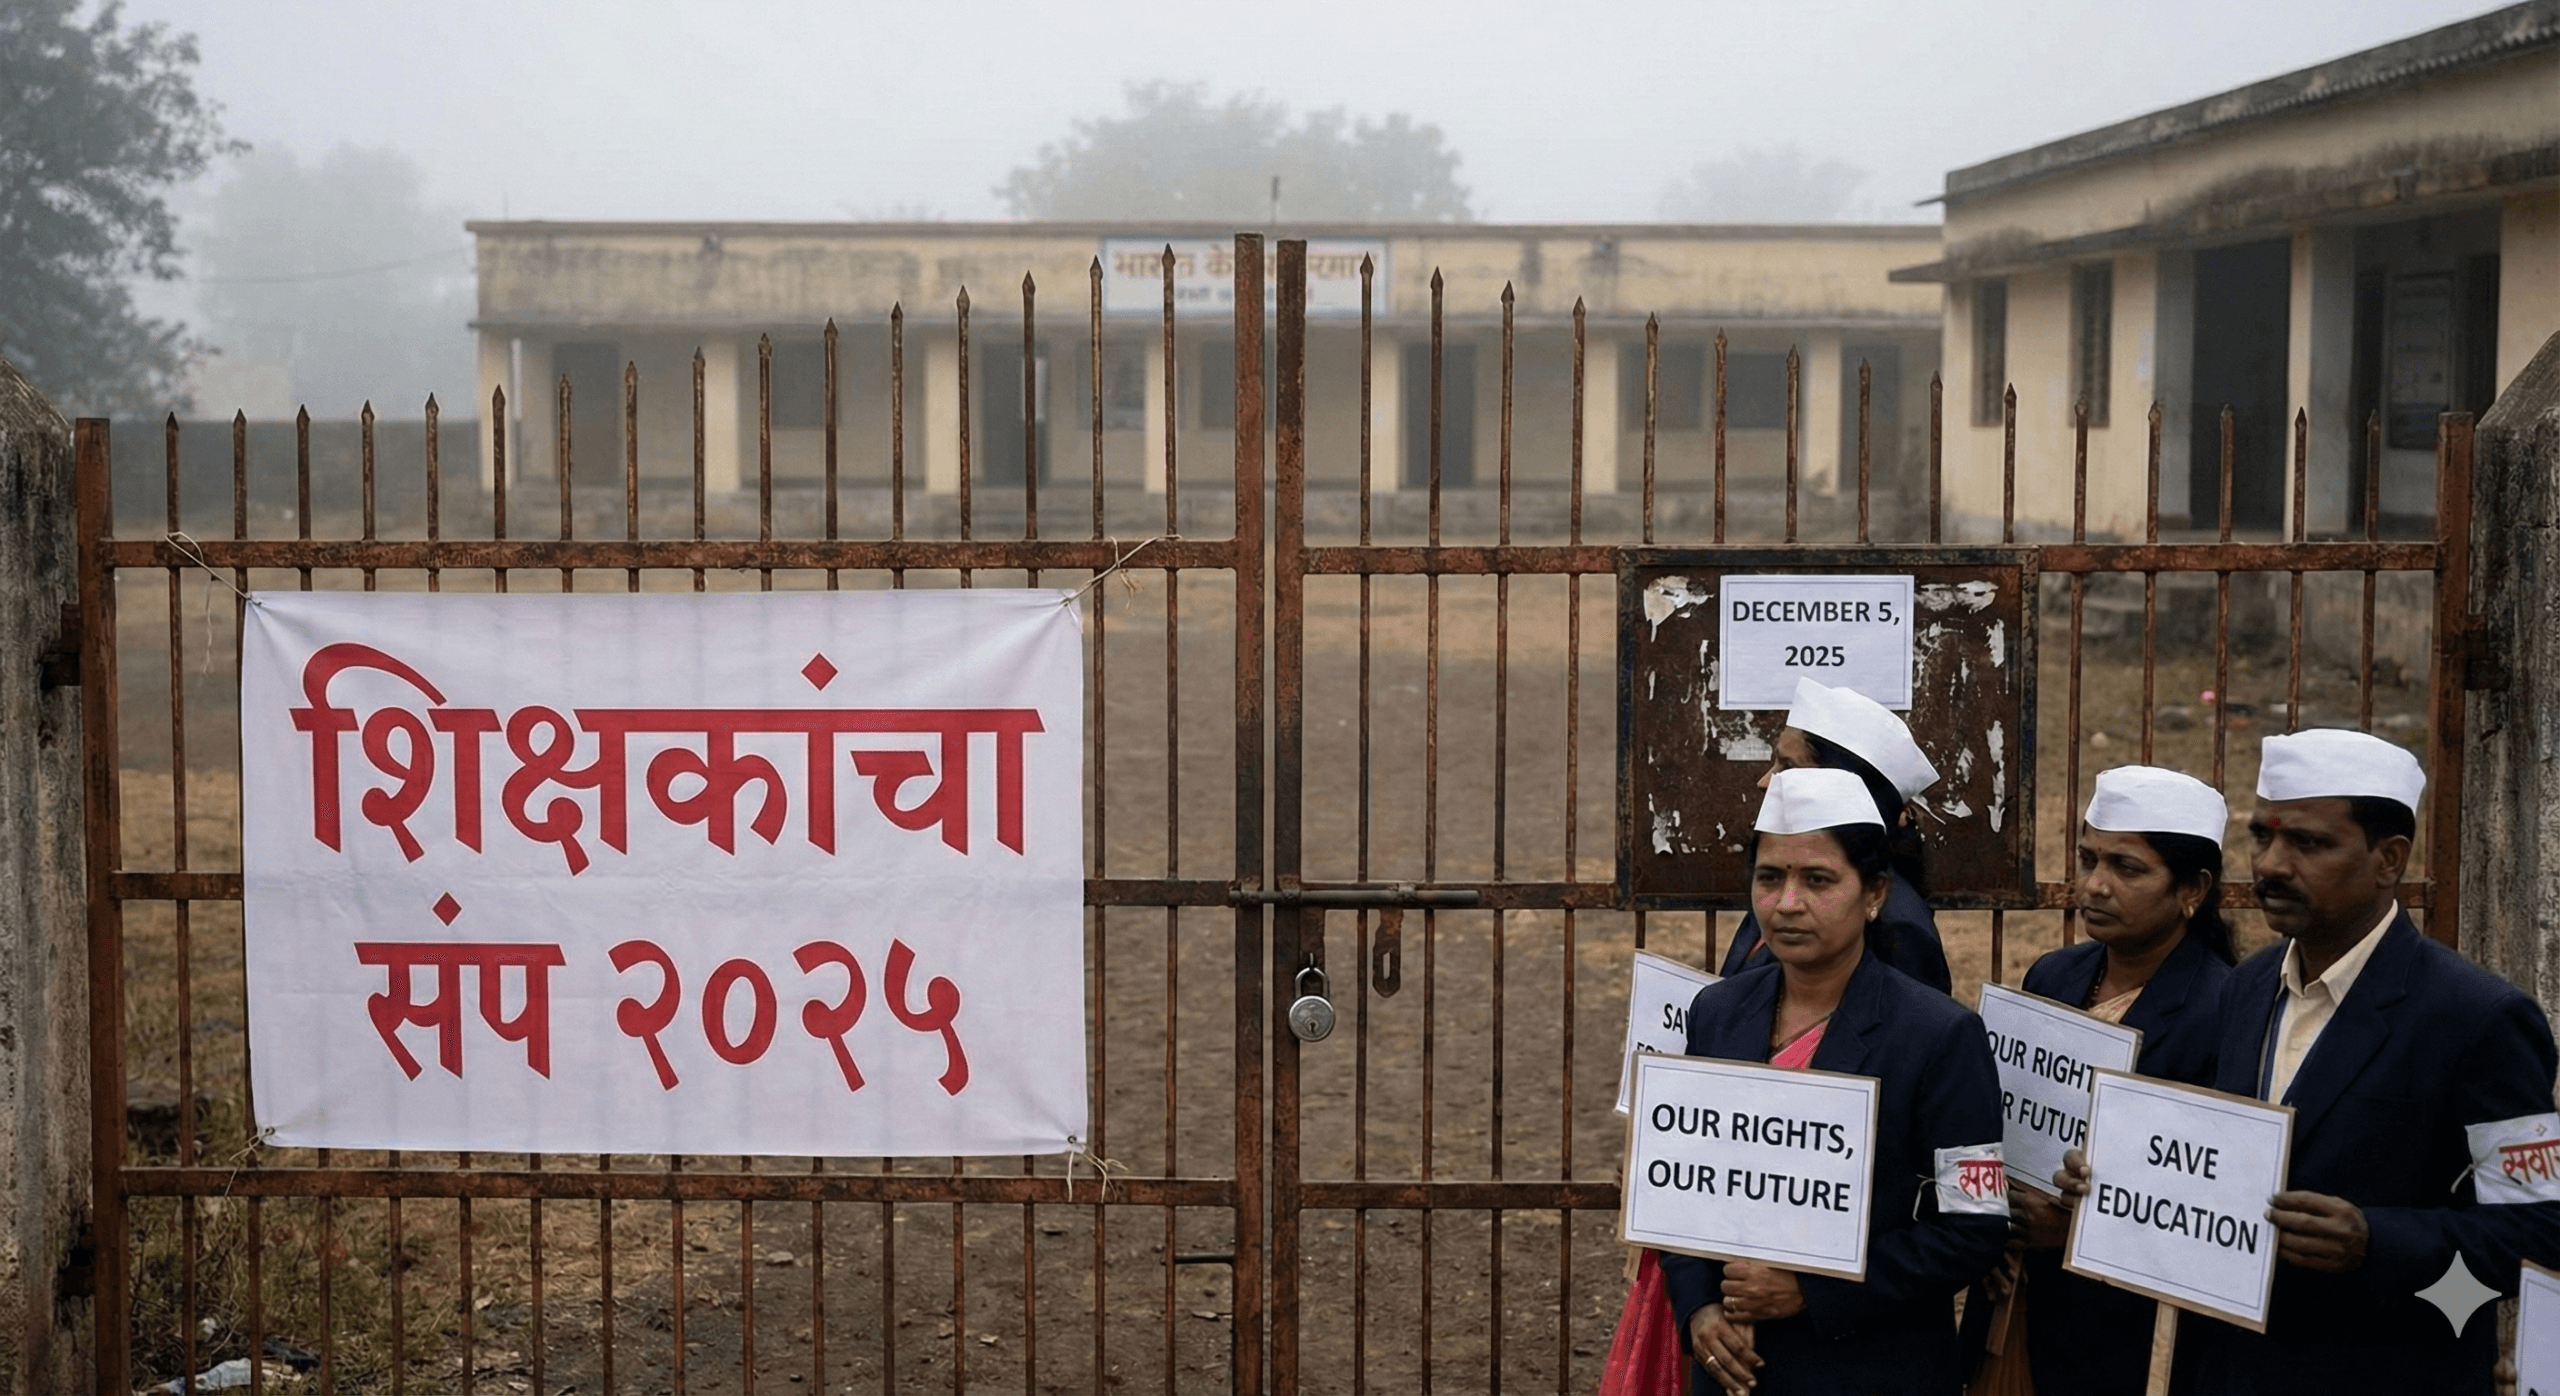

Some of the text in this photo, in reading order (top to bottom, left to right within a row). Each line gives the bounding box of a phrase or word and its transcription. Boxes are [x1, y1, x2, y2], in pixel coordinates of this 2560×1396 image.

[1733, 600, 1900, 626] DECEMBER 5,
[1785, 645, 1845, 667] 2025
[291, 643, 1044, 875] शिक्षकांचा
[355, 892, 973, 1096] संप २०२५
[1651, 1103, 1854, 1160] OUR RIGHTS,
[2147, 1134, 2219, 1181] SAVE
[1648, 1159, 1851, 1213] OUR FUTURE
[2097, 1183, 2259, 1255] EDUCATION
